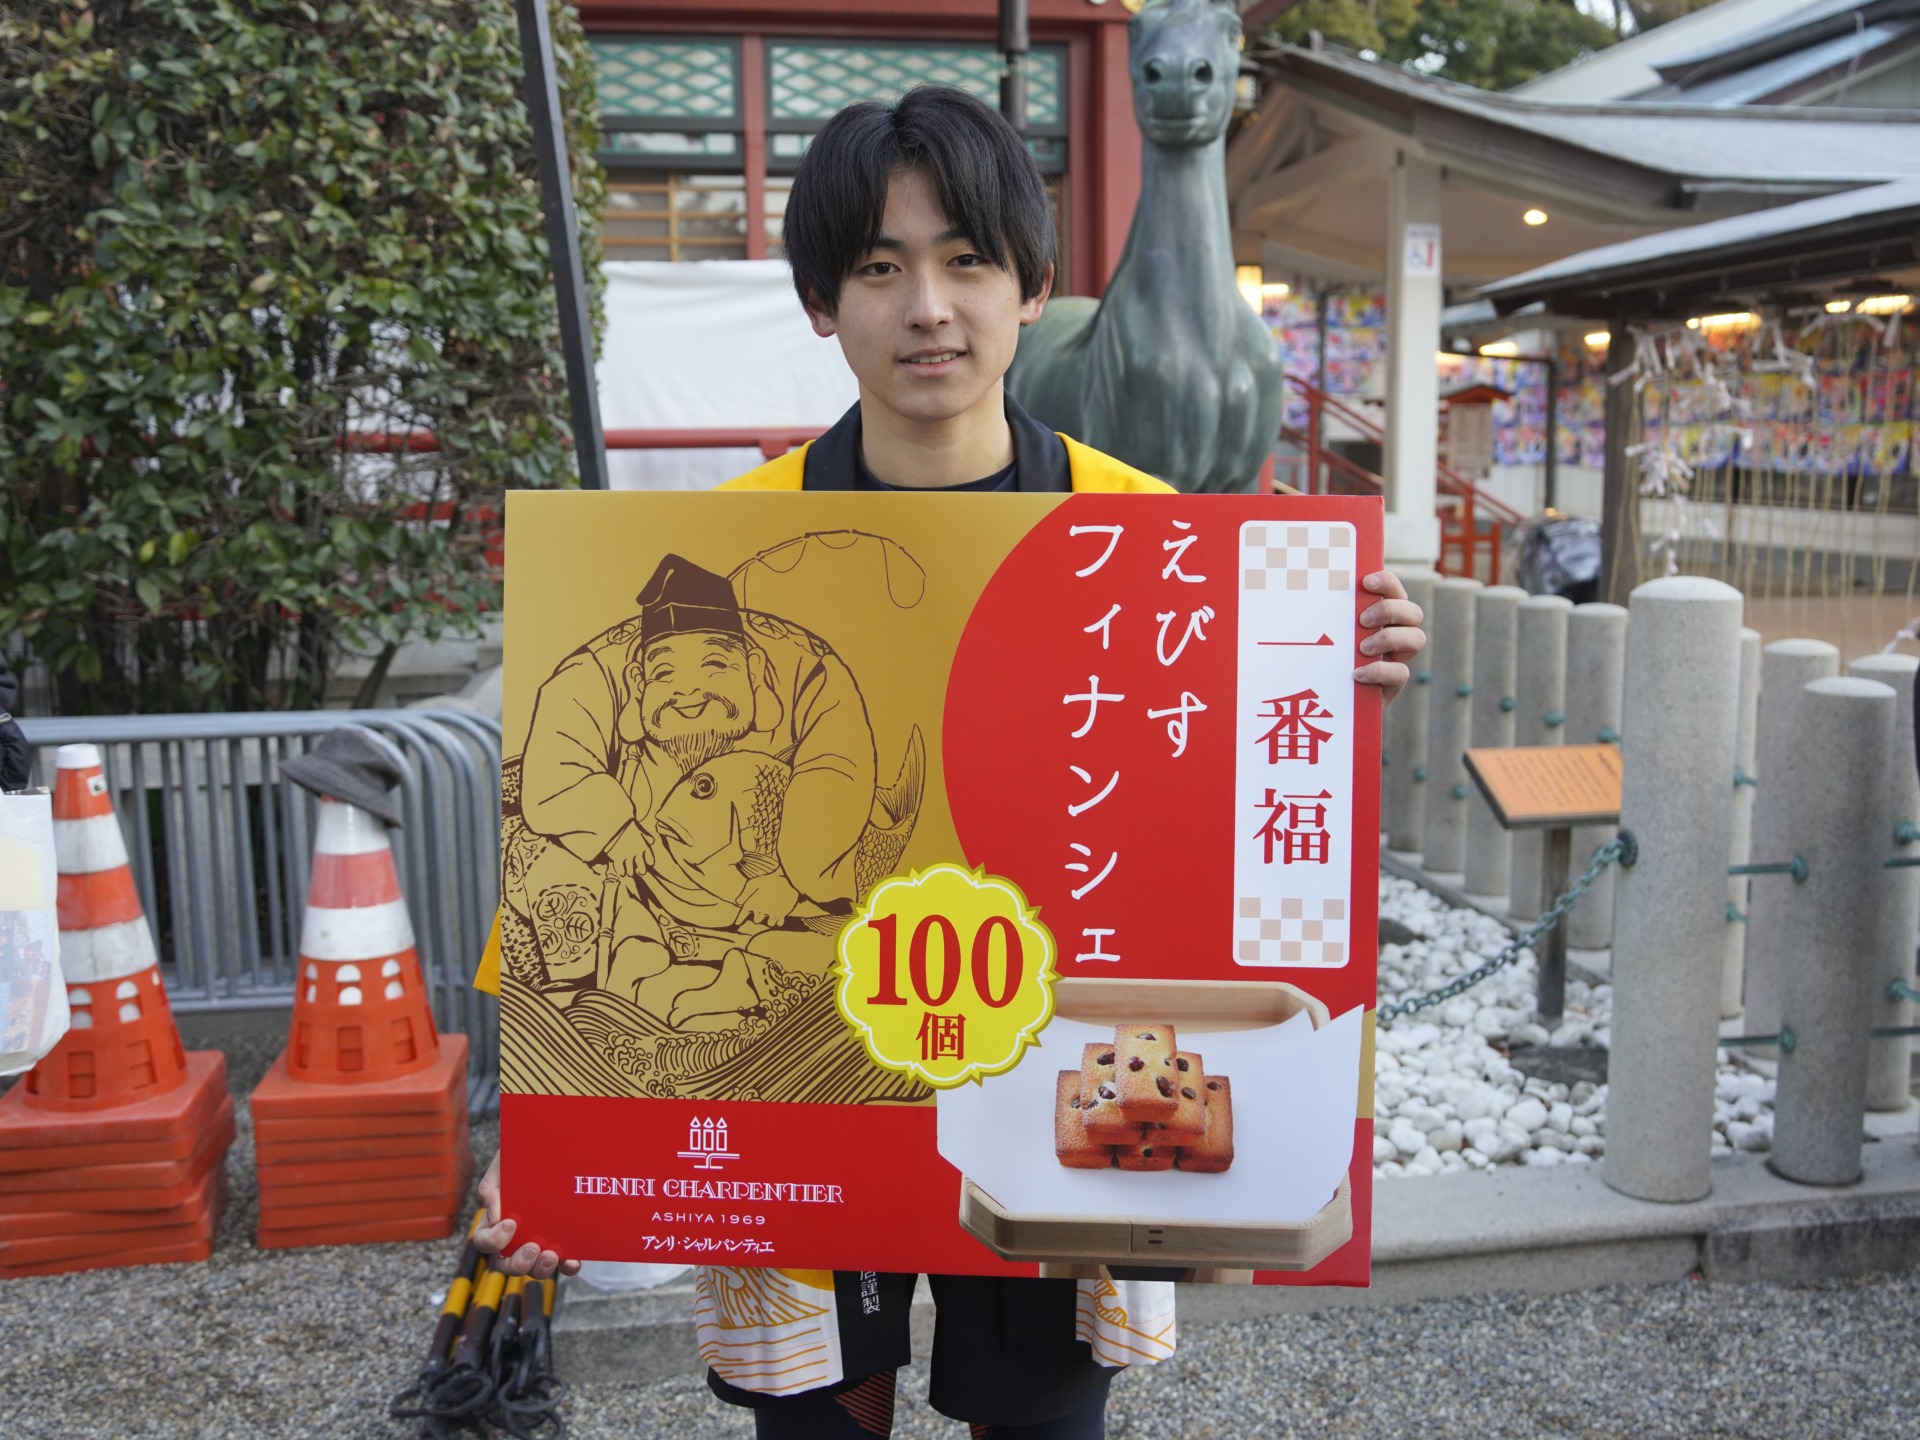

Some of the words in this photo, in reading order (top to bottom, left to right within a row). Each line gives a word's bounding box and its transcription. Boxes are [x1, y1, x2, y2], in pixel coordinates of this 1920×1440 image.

[1147, 520, 1215, 758] えびす
[1062, 524, 1125, 963] フィナンシェ
[1252, 632, 1334, 865] 一番福
[867, 913, 1024, 1008] 100
[915, 1012, 966, 1061] 個
[574, 1175, 656, 1197] HENRI
[662, 1178, 844, 1203] CHARPENTIER
[651, 1212, 715, 1224] ASHIYA
[720, 1214, 766, 1225] 1969
[641, 1235, 775, 1253] アンリ・シャルパンティエ
